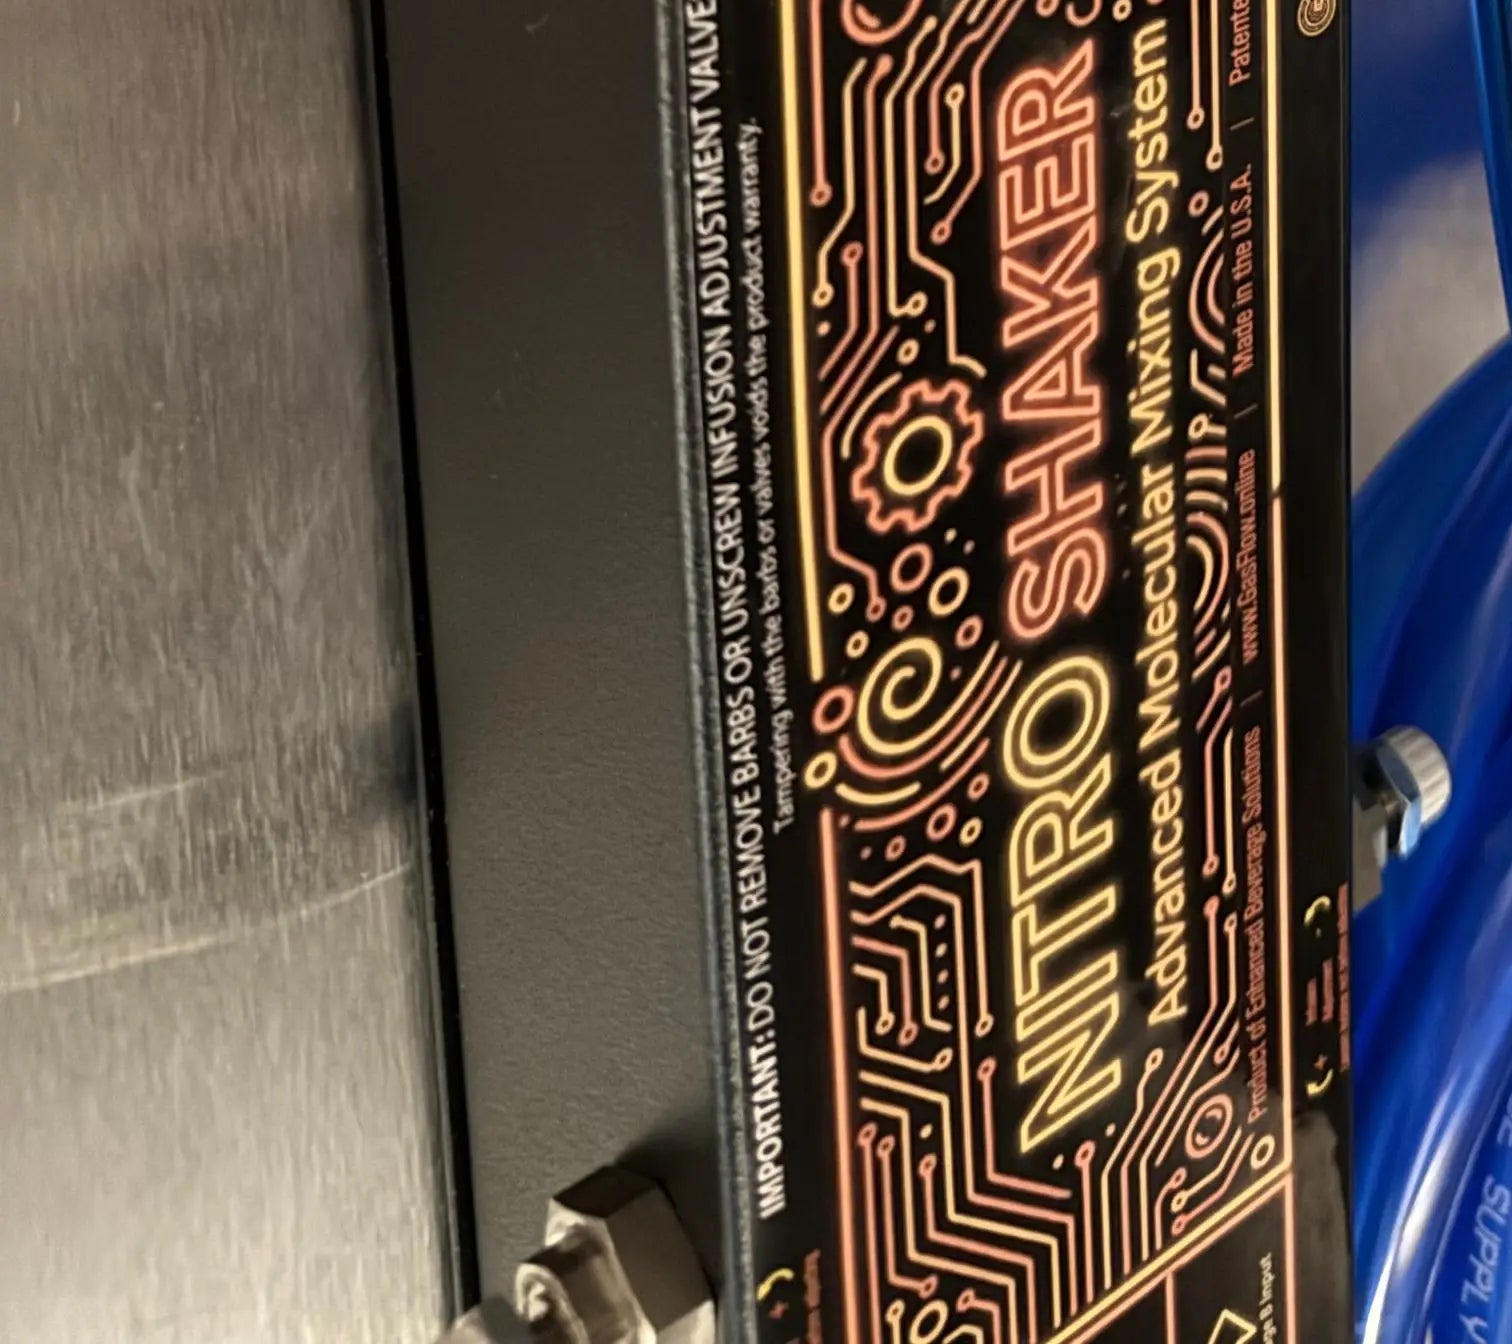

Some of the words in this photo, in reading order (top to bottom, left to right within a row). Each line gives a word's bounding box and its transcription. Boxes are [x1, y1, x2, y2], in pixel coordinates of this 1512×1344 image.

[736, 116, 764, 232] warranty.
[1125, 18, 1178, 236] System
[691, 106, 731, 317] ADJUSTMENT
[1230, 165, 1253, 238] U.S.A.
[741, 236, 766, 332] product
[1232, 241, 1252, 280] the
[1232, 283, 1252, 307] in
[745, 334, 768, 376] the
[997, 41, 1108, 640] SHAKER
[1130, 245, 1181, 451] Mixing
[1232, 310, 1253, 375] Made
[704, 324, 738, 476] INFUSION
[747, 379, 770, 442] voids
[752, 445, 774, 516] valves
[714, 483, 750, 635] UNSCREW
[758, 518, 776, 543] or
[758, 548, 782, 612] barbs
[1135, 461, 1182, 742] Molecular
[722, 636, 753, 681] OR
[761, 616, 784, 656] the
[763, 658, 787, 707] with
[724, 685, 761, 782] BARBS
[768, 711, 797, 834] Tampering
[1242, 726, 1262, 820] Solutions
[732, 788, 767, 908] REMOVE
[1140, 748, 1190, 1024] Advanced
[1242, 824, 1265, 916] Beverage
[740, 915, 771, 974] NOT
[1002, 654, 1121, 1154] NITRO
[744, 980, 776, 1029] DO
[1243, 920, 1265, 1016] Enhanced
[1245, 1019, 1265, 1039] of
[747, 1029, 787, 1218] IMPORTANT:
[1245, 1041, 1267, 1122] Product
[1460, 1175, 1512, 1344] SUPPLY
